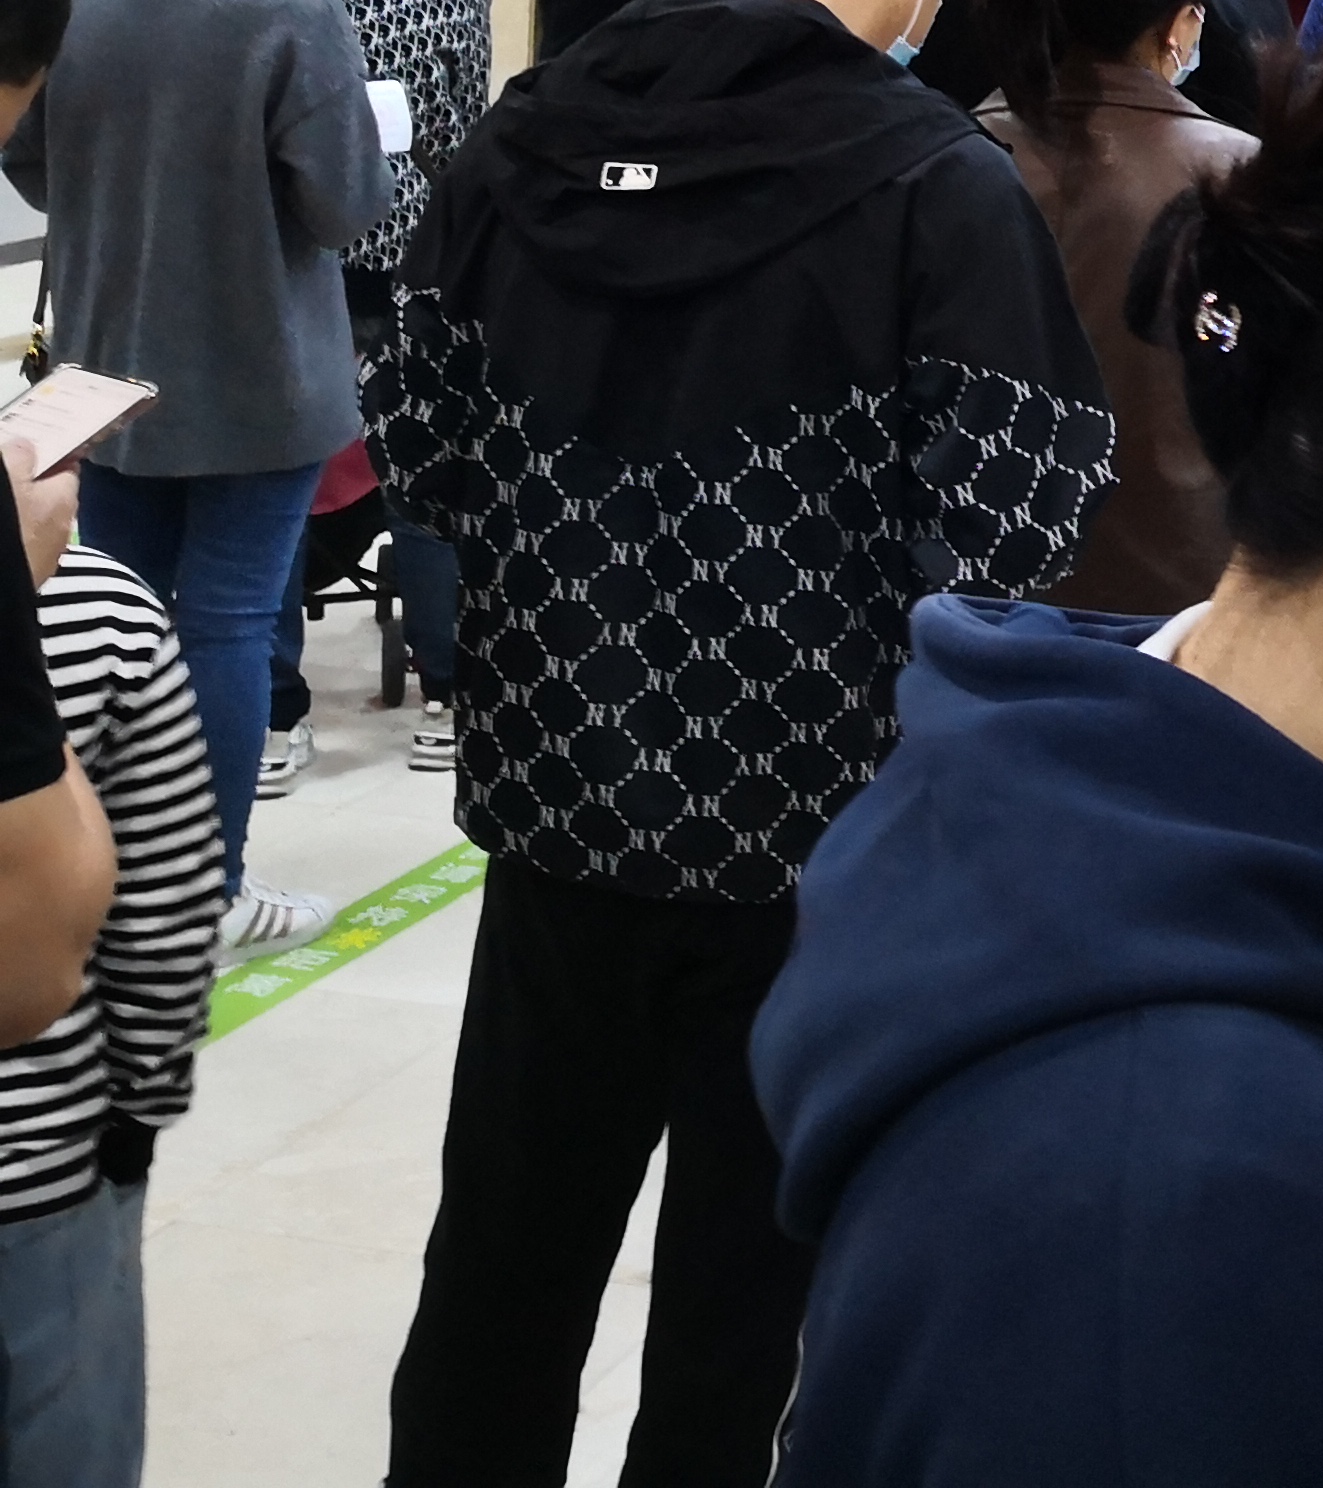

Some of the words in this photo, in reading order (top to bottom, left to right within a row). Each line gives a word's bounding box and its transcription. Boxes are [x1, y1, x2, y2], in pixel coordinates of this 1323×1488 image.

[799, 414, 836, 437] NY
[978, 426, 1013, 460] NY
[562, 498, 603, 523] NY
[746, 523, 785, 549] NY
[610, 542, 648, 566] NY
[692, 559, 730, 584] NY
[797, 568, 835, 593] NY
[957, 557, 990, 581] NY
[740, 677, 777, 703] NY
[586, 702, 628, 728] NY
[685, 716, 724, 740] NY
[789, 722, 828, 745] NY
[734, 832, 773, 854] NY
